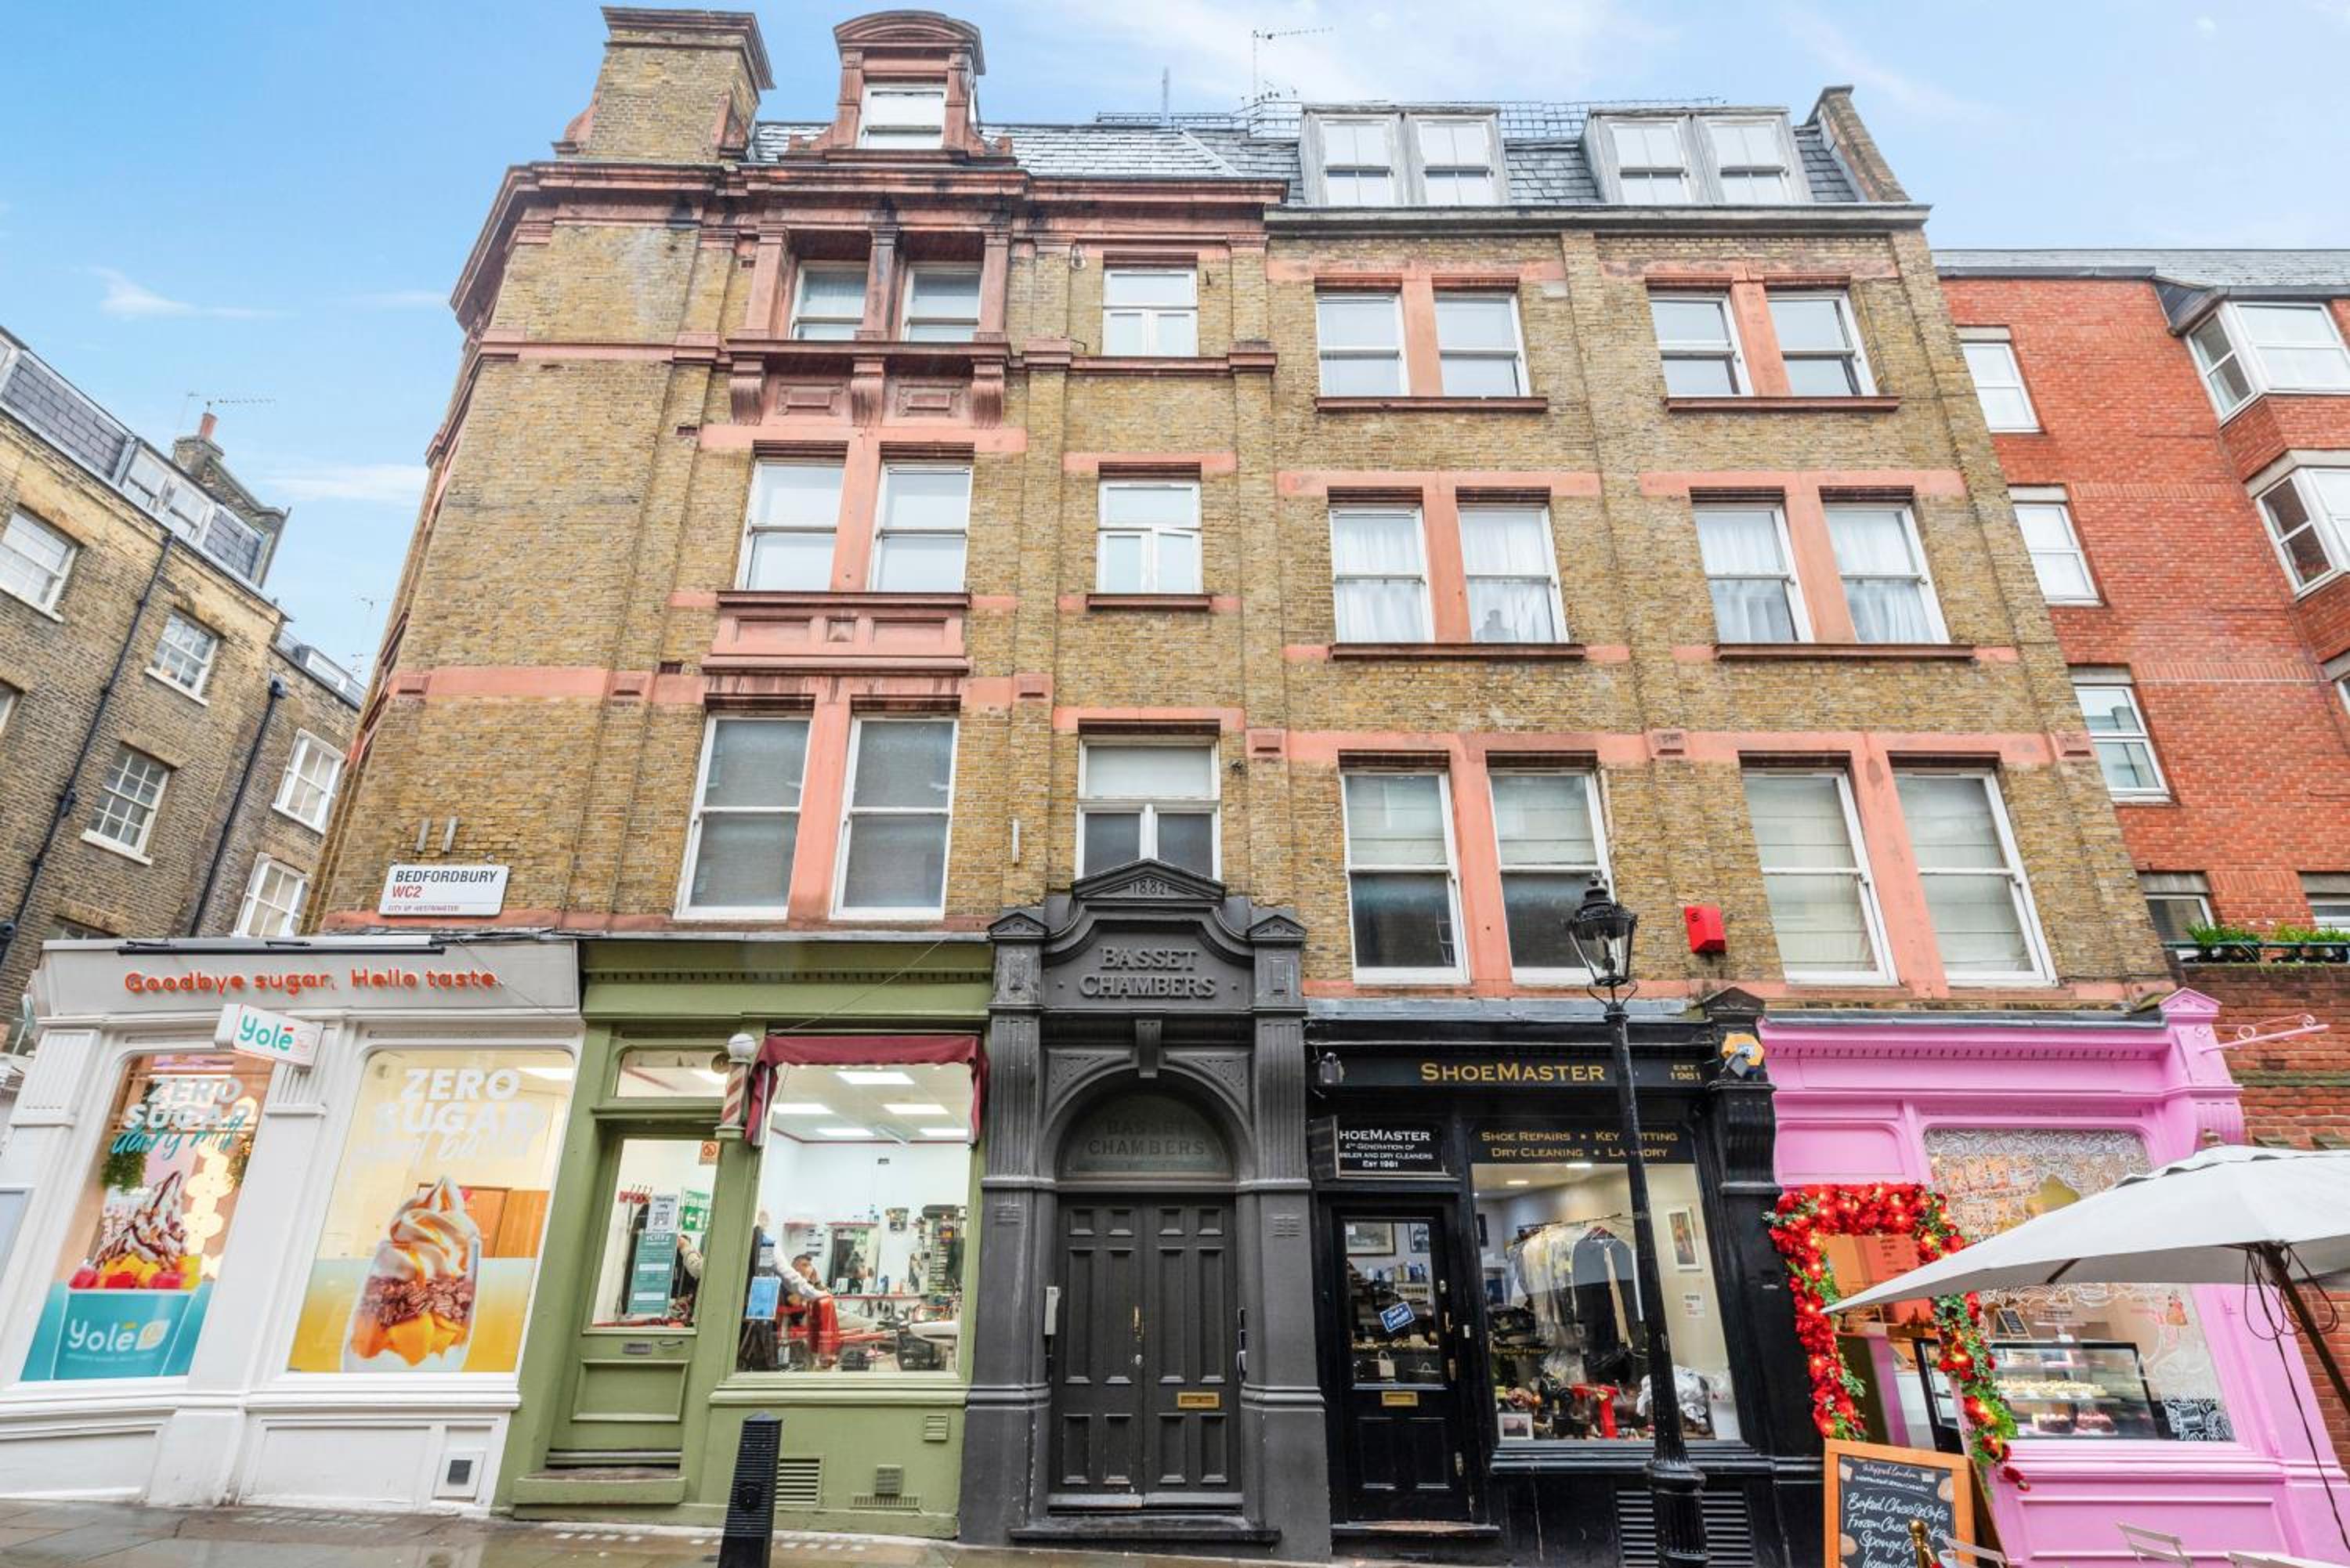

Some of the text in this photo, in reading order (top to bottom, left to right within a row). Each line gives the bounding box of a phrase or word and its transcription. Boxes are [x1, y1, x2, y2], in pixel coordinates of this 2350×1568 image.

[395, 870, 498, 883] BEDFORDBURY
[392, 886, 422, 898] WC2
[1133, 880, 1166, 895] 1882
[1100, 946, 1199, 971] BASSET
[125, 972, 245, 995] Goodbye
[351, 968, 418, 988] Hello
[1079, 974, 1217, 999] CHAMBERS
[400, 1068, 521, 1101] ZERO
[1669, 1071, 1701, 1081] 1981
[146, 1077, 245, 1104] ZERO
[1519, 1132, 1571, 1141] REPAIRS
[1595, 1132, 1619, 1141] KEY
[1088, 1140, 1204, 1155] CHAMBERS
[1491, 1147, 1517, 1158] DRY
[1520, 1147, 1584, 1158] CLEANING
[1847, 1492, 1885, 1513] Baked
[1859, 1530, 1902, 1557] Sponge
